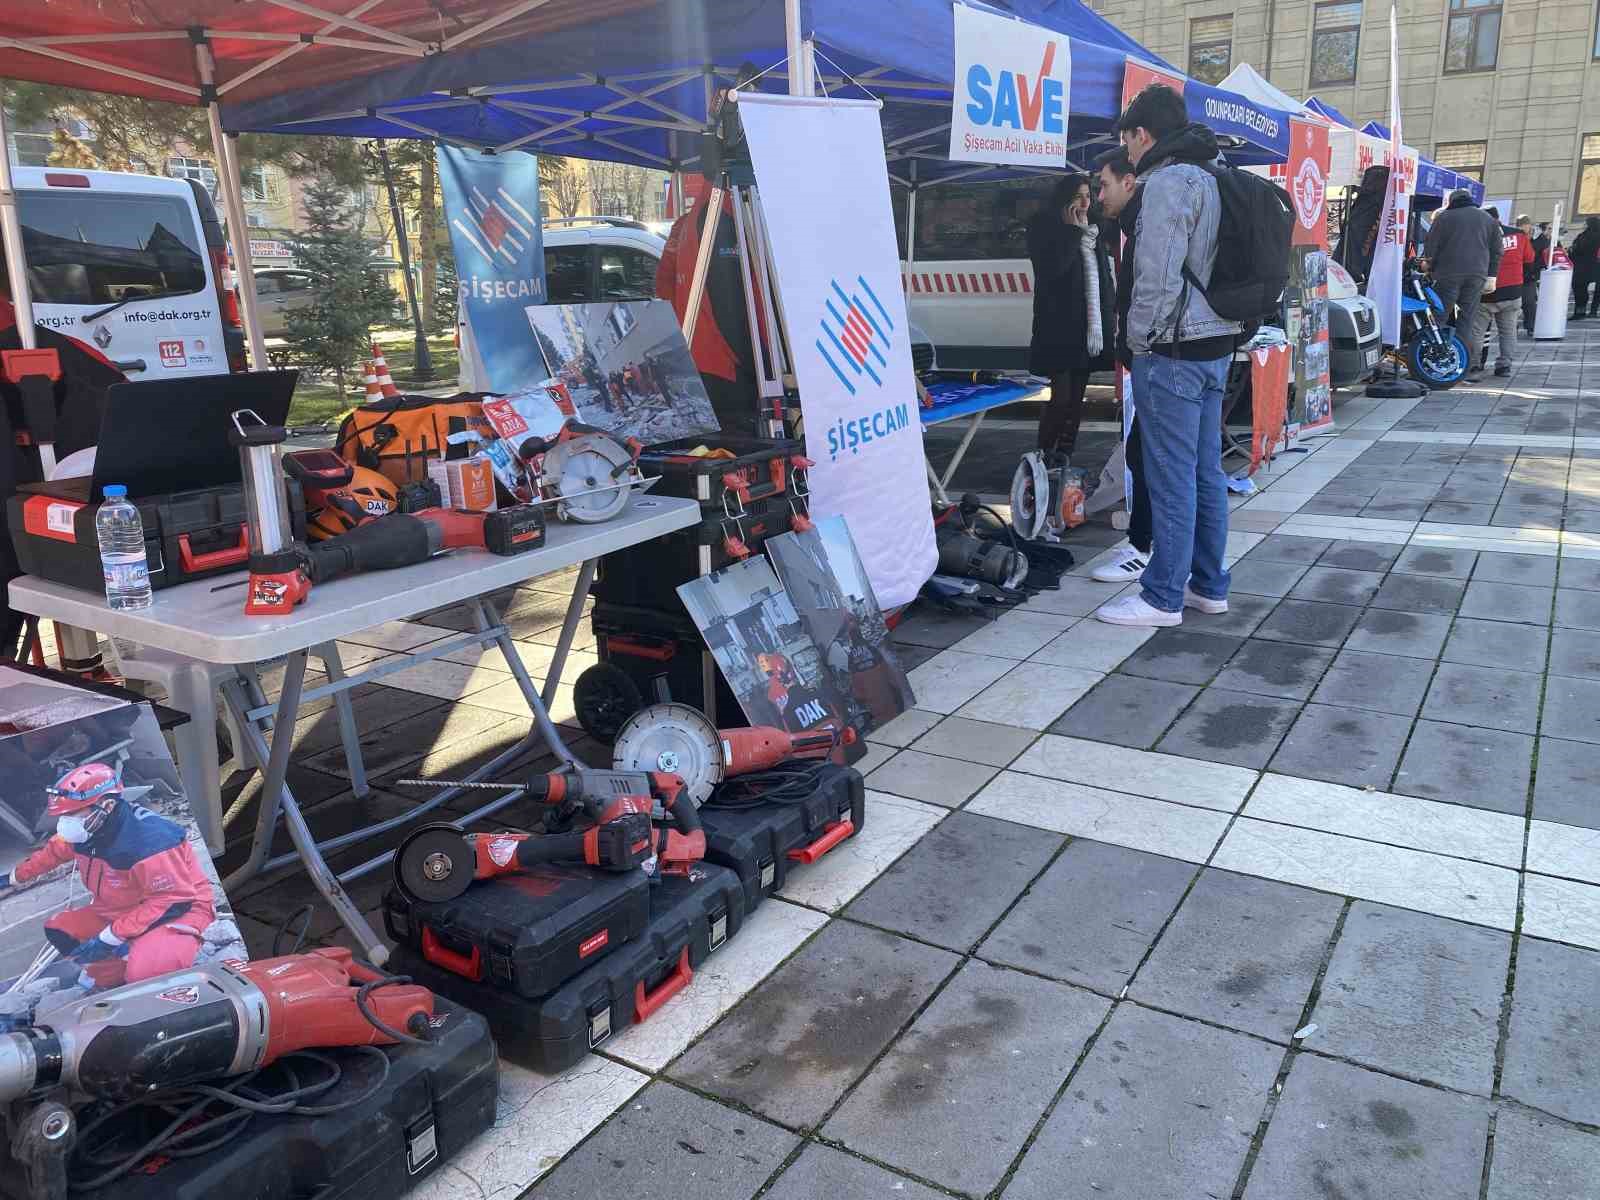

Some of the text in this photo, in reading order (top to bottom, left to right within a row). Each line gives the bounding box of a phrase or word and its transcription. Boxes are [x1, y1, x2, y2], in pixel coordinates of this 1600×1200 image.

[966, 41, 1064, 134] SAVE
[1205, 98, 1245, 124] ODUNPAZARI
[124, 310, 211, 324] info@dak.org.tr
[161, 343, 181, 357] 112
[828, 403, 909, 461] ŞİŞECAM
[367, 500, 388, 511] DAK
[795, 698, 827, 729] DAK
